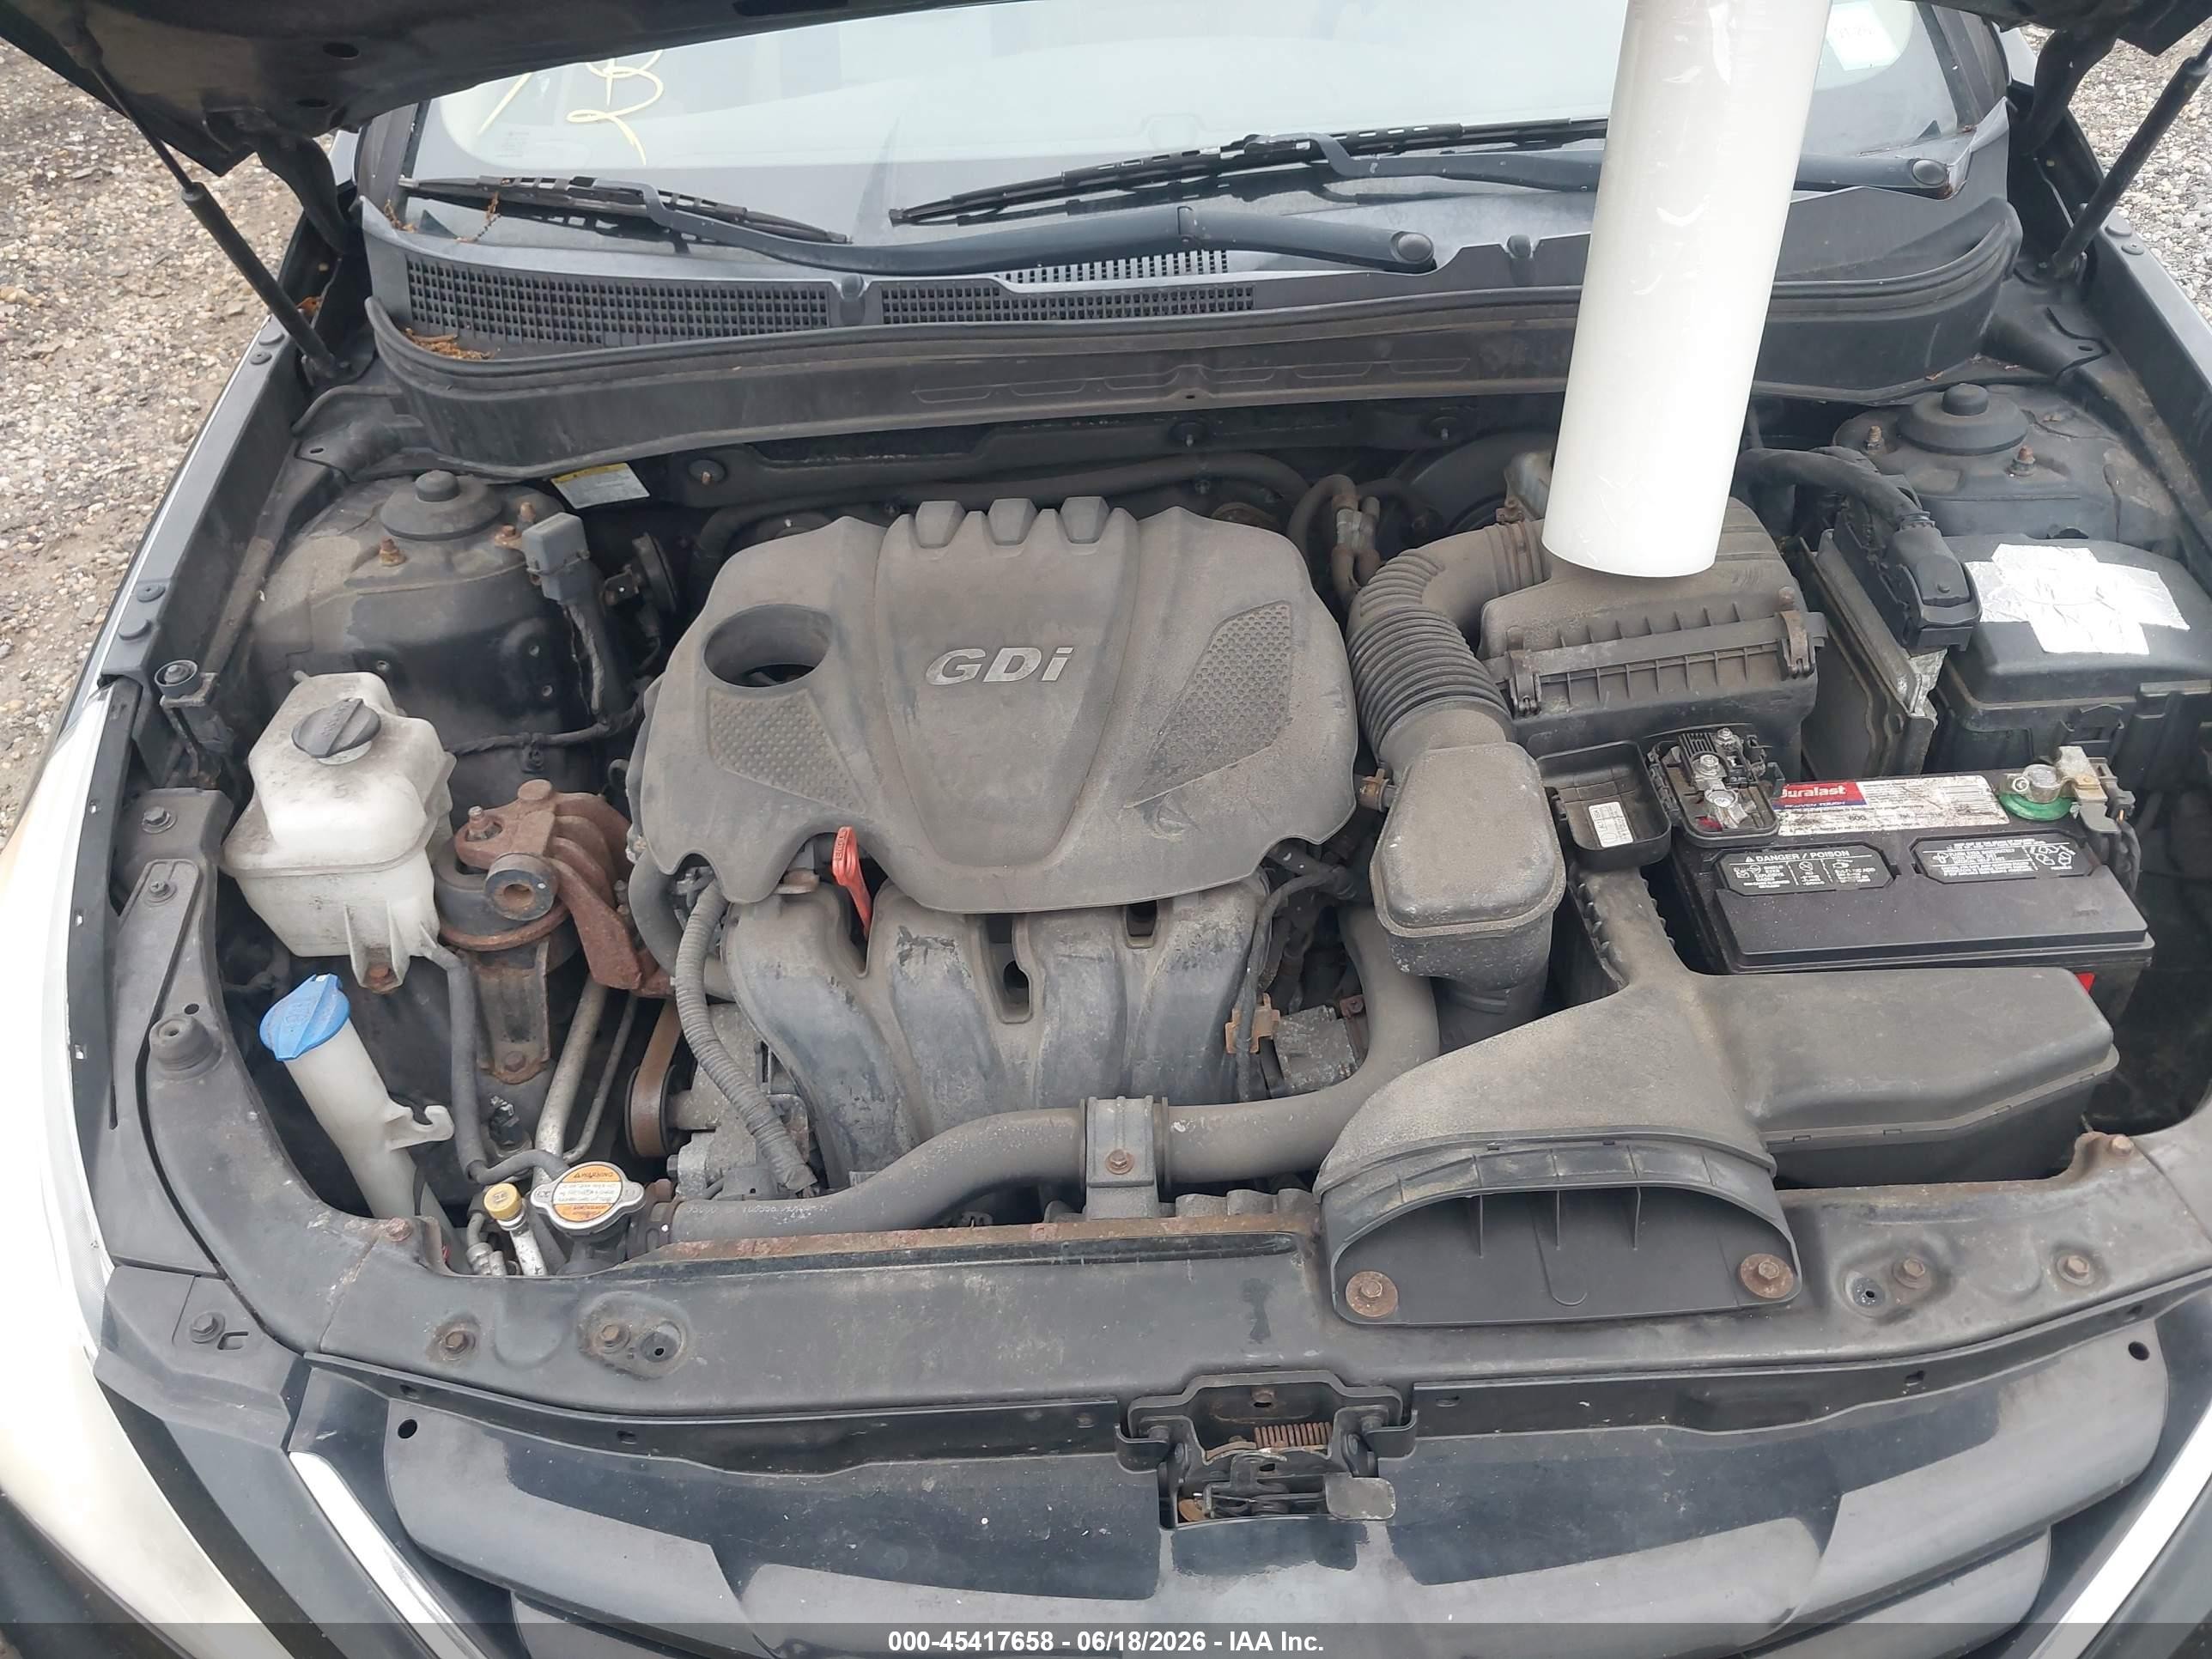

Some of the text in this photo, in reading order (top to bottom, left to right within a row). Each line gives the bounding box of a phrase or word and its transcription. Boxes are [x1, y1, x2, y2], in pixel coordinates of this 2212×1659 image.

[926, 647, 1074, 686] GDi
[1755, 853, 1800, 862] DANGER
[1809, 850, 1850, 859] POISON
